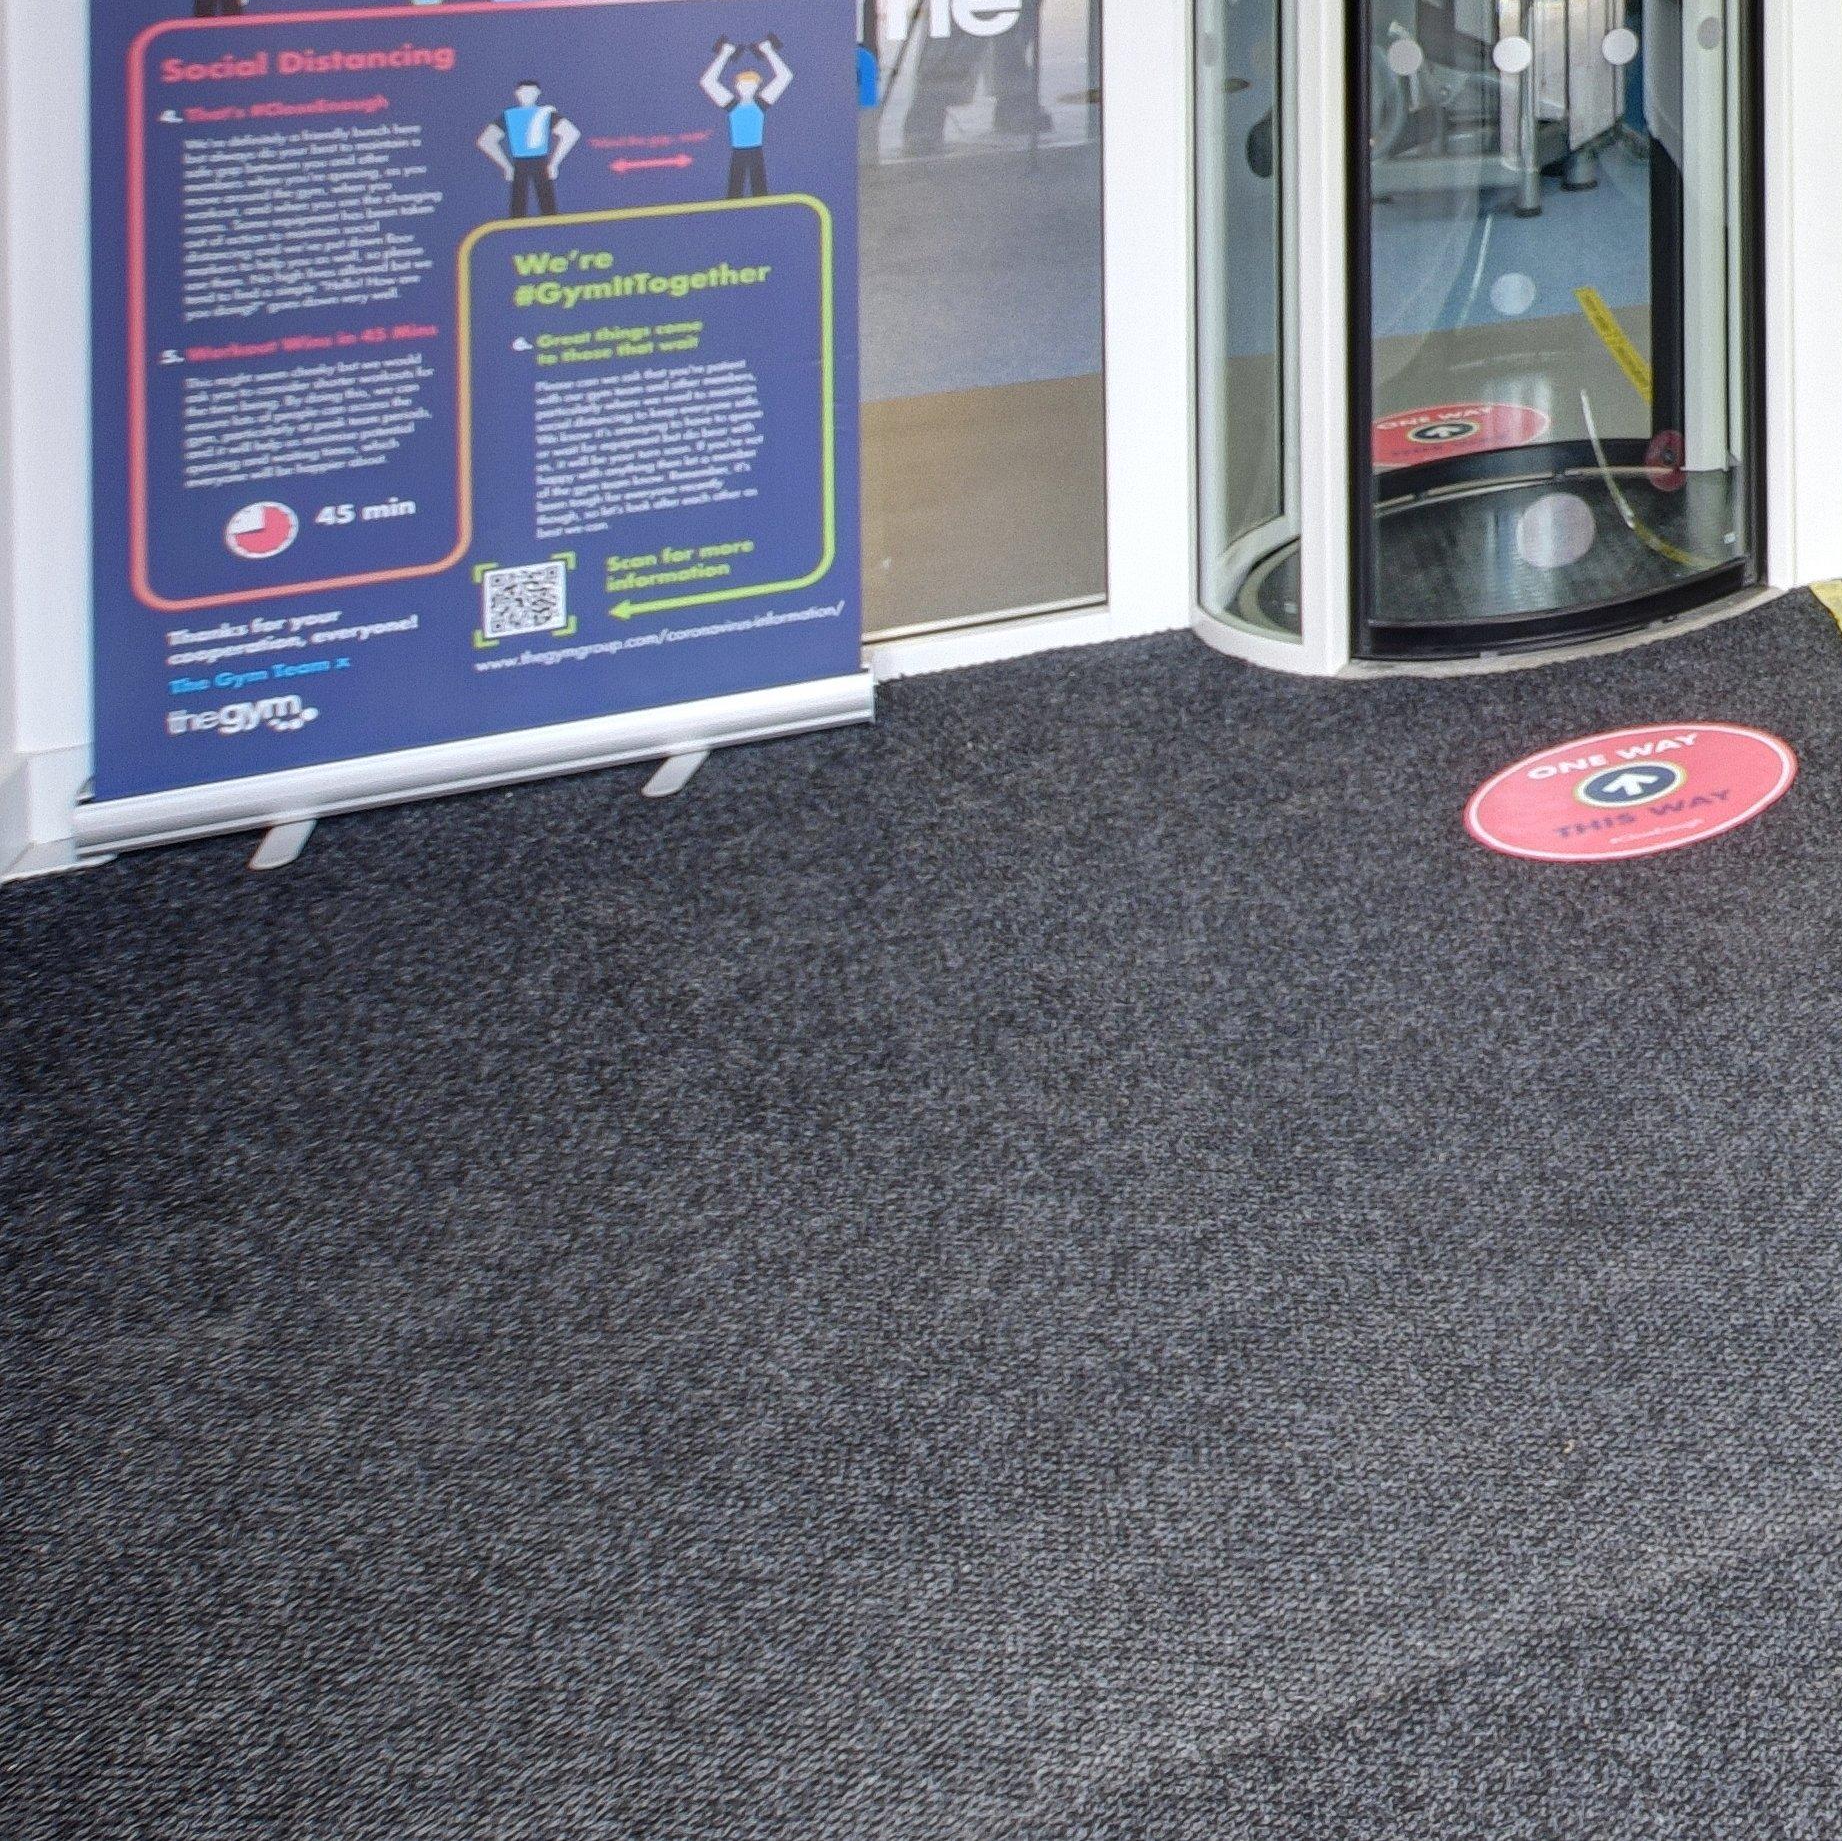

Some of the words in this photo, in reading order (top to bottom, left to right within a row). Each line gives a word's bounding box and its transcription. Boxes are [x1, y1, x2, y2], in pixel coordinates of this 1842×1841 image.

[161, 51, 269, 84] Social
[277, 43, 456, 74] Distancing
[513, 249, 614, 277] We're
[314, 503, 356, 526] 45
[360, 496, 416, 521] min
[1527, 753, 1608, 780] ONE
[1615, 733, 1698, 759] WAY
[1555, 812, 1636, 838] THIS
[1651, 789, 1730, 816] WAY
